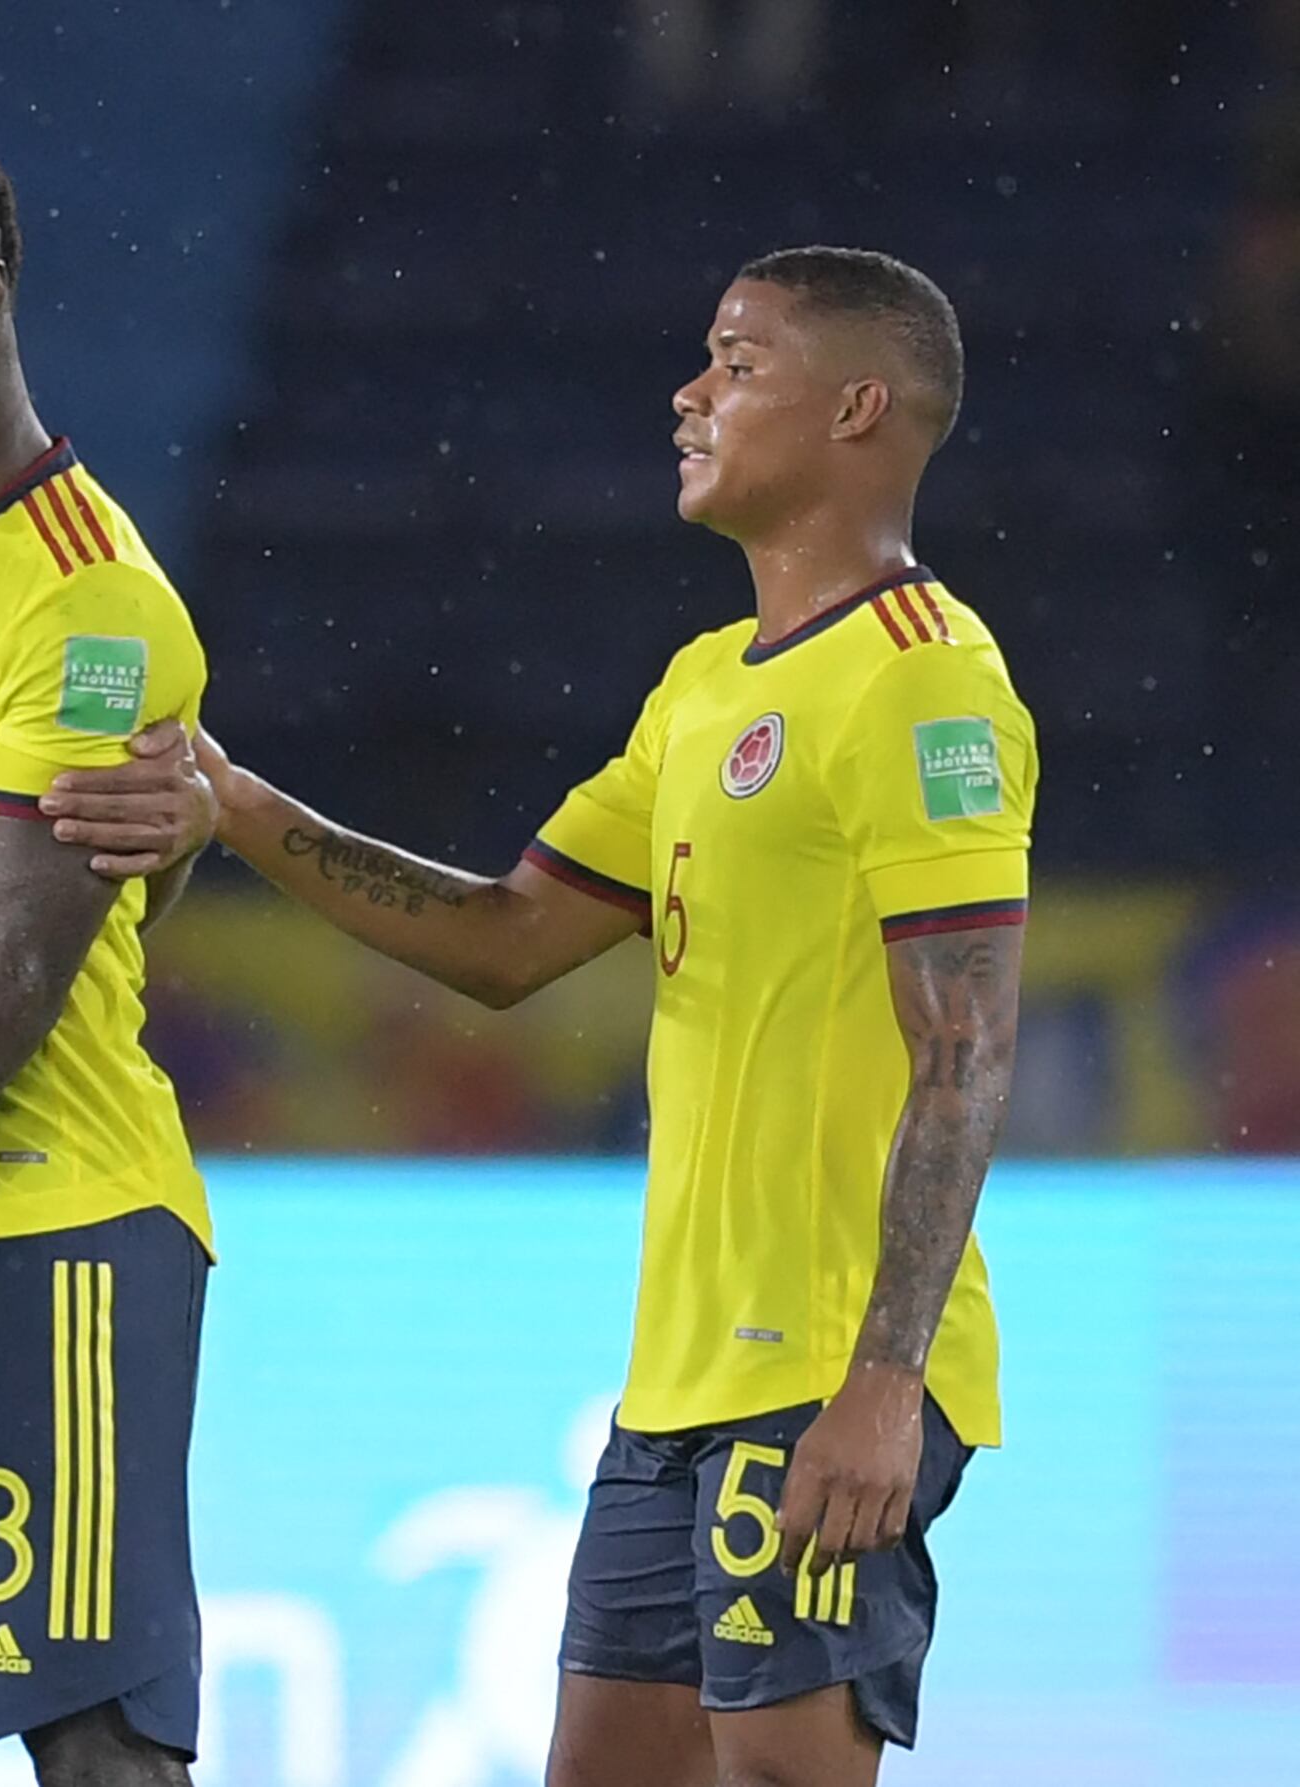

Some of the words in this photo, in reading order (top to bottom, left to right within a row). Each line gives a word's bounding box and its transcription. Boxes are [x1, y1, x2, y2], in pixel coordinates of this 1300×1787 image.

[71, 663, 140, 677] LIVING
[71, 674, 138, 688] FOOTBALL
[660, 842, 691, 977] 5
[711, 1440, 786, 1577] 5
[713, 1622, 775, 1647] adidas
